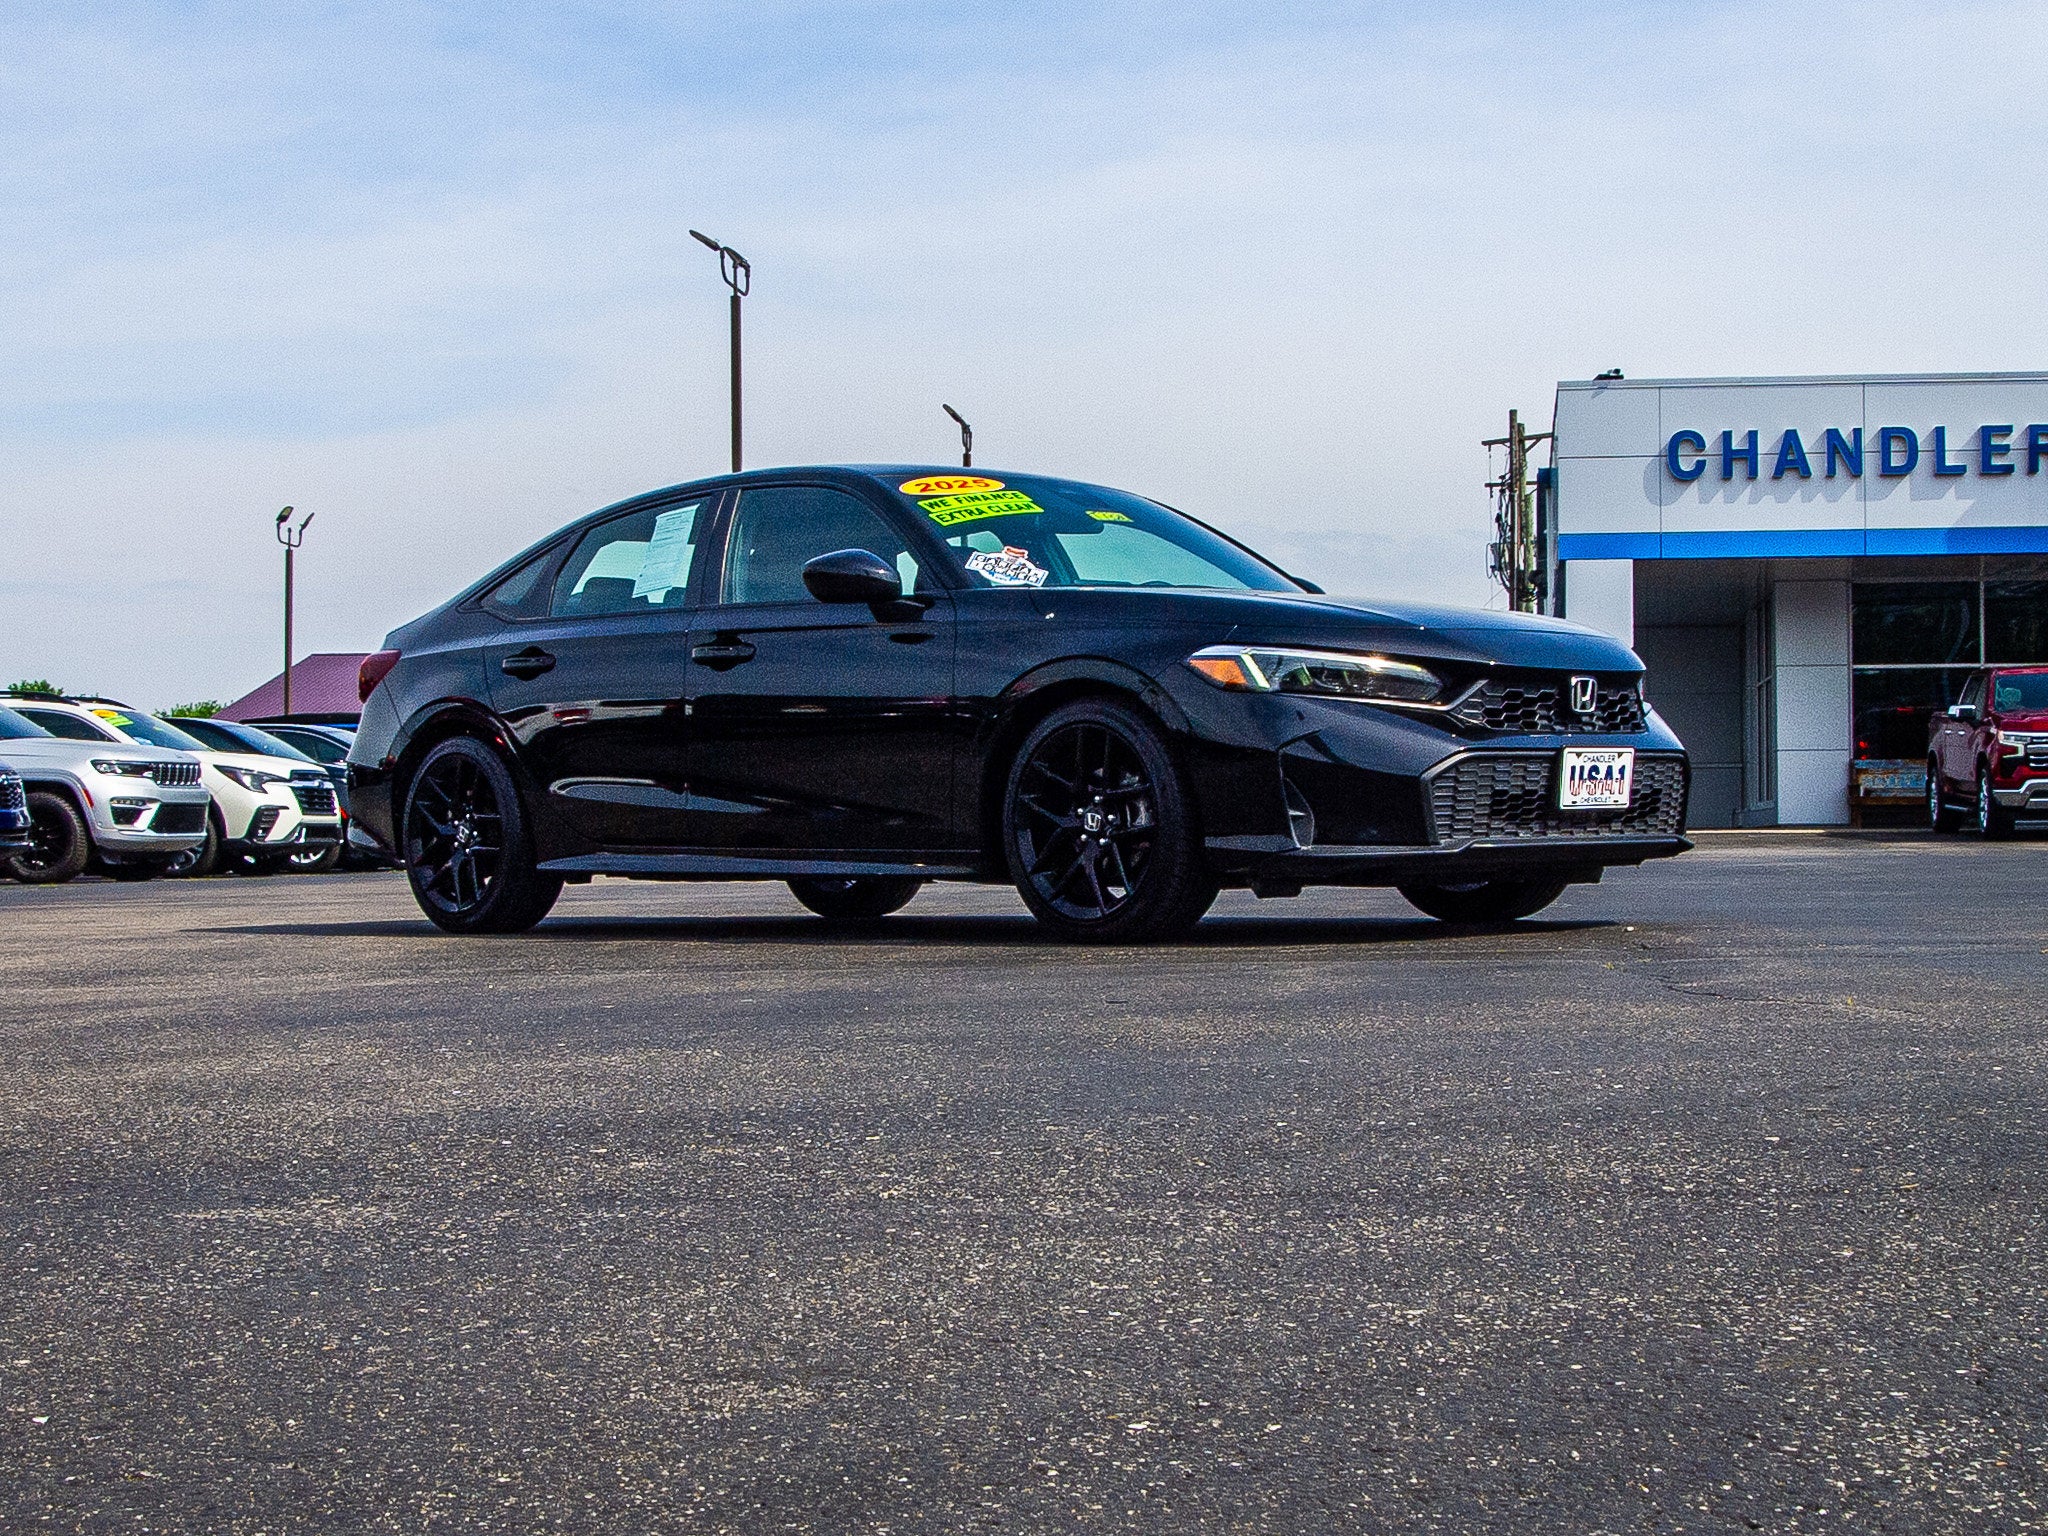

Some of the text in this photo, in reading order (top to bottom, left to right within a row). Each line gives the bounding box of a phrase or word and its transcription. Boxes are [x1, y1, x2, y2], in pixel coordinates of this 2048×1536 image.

[915, 479, 991, 492] 2025
[925, 492, 1024, 509] WE FINANCE
[935, 502, 1036, 522] EXTRA CLEAN
[1583, 755, 1616, 763] CHANDLER
